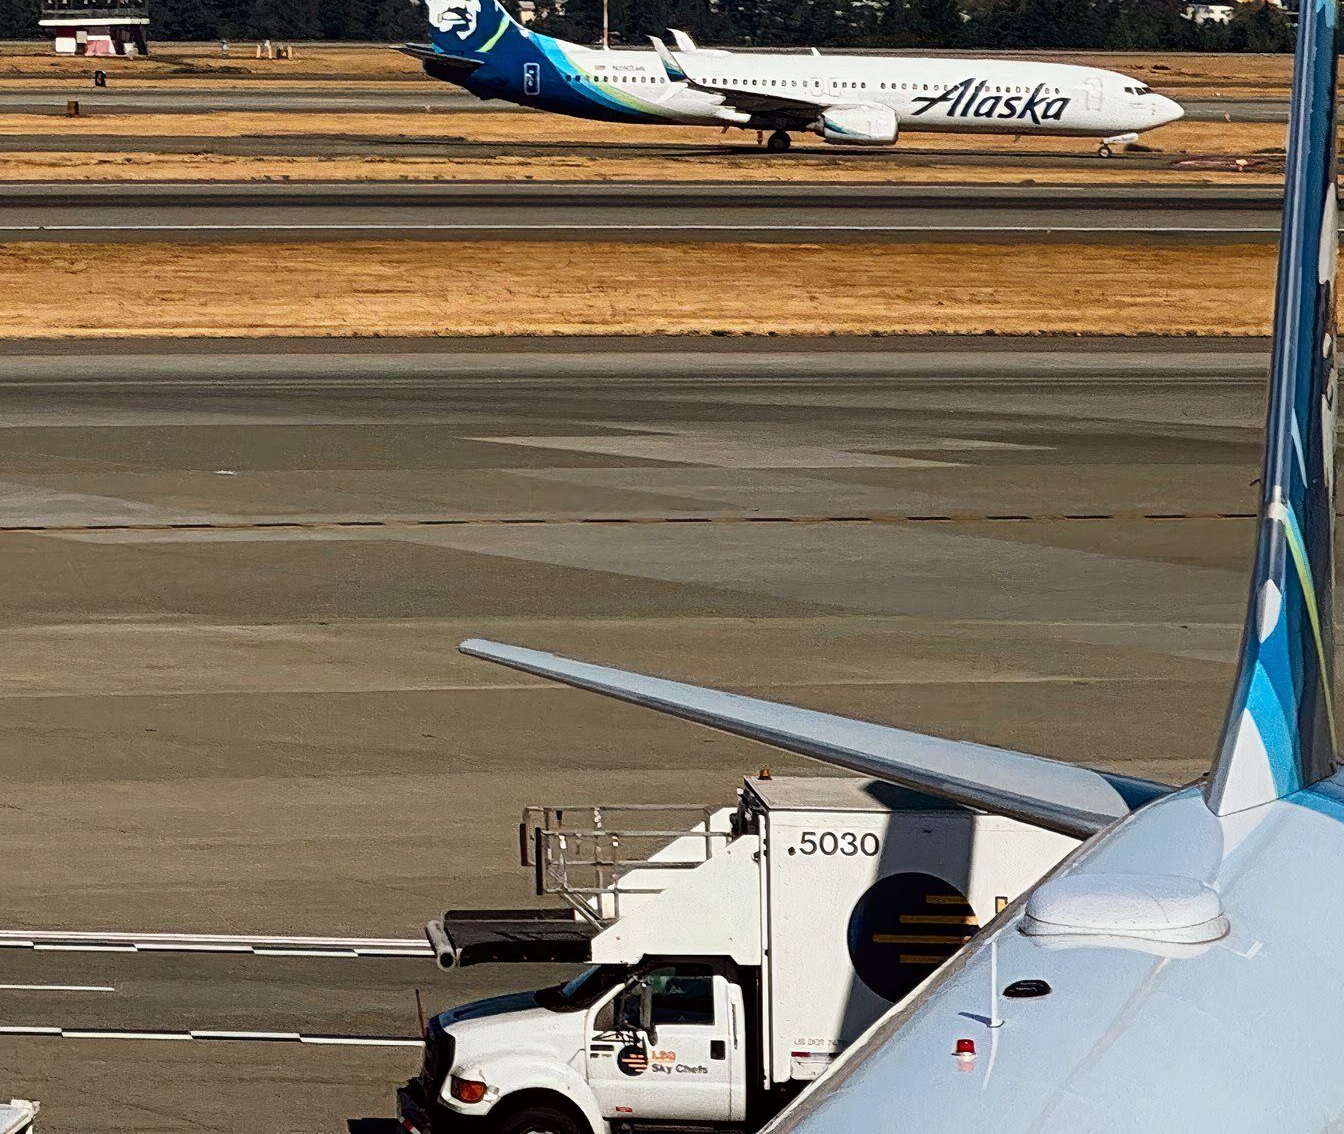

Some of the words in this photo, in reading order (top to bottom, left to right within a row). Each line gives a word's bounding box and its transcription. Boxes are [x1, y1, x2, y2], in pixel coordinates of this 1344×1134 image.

[911, 77, 1072, 125] Alaska
[651, 1063, 672, 1074] Sky
[675, 1063, 709, 1074] Chefs
